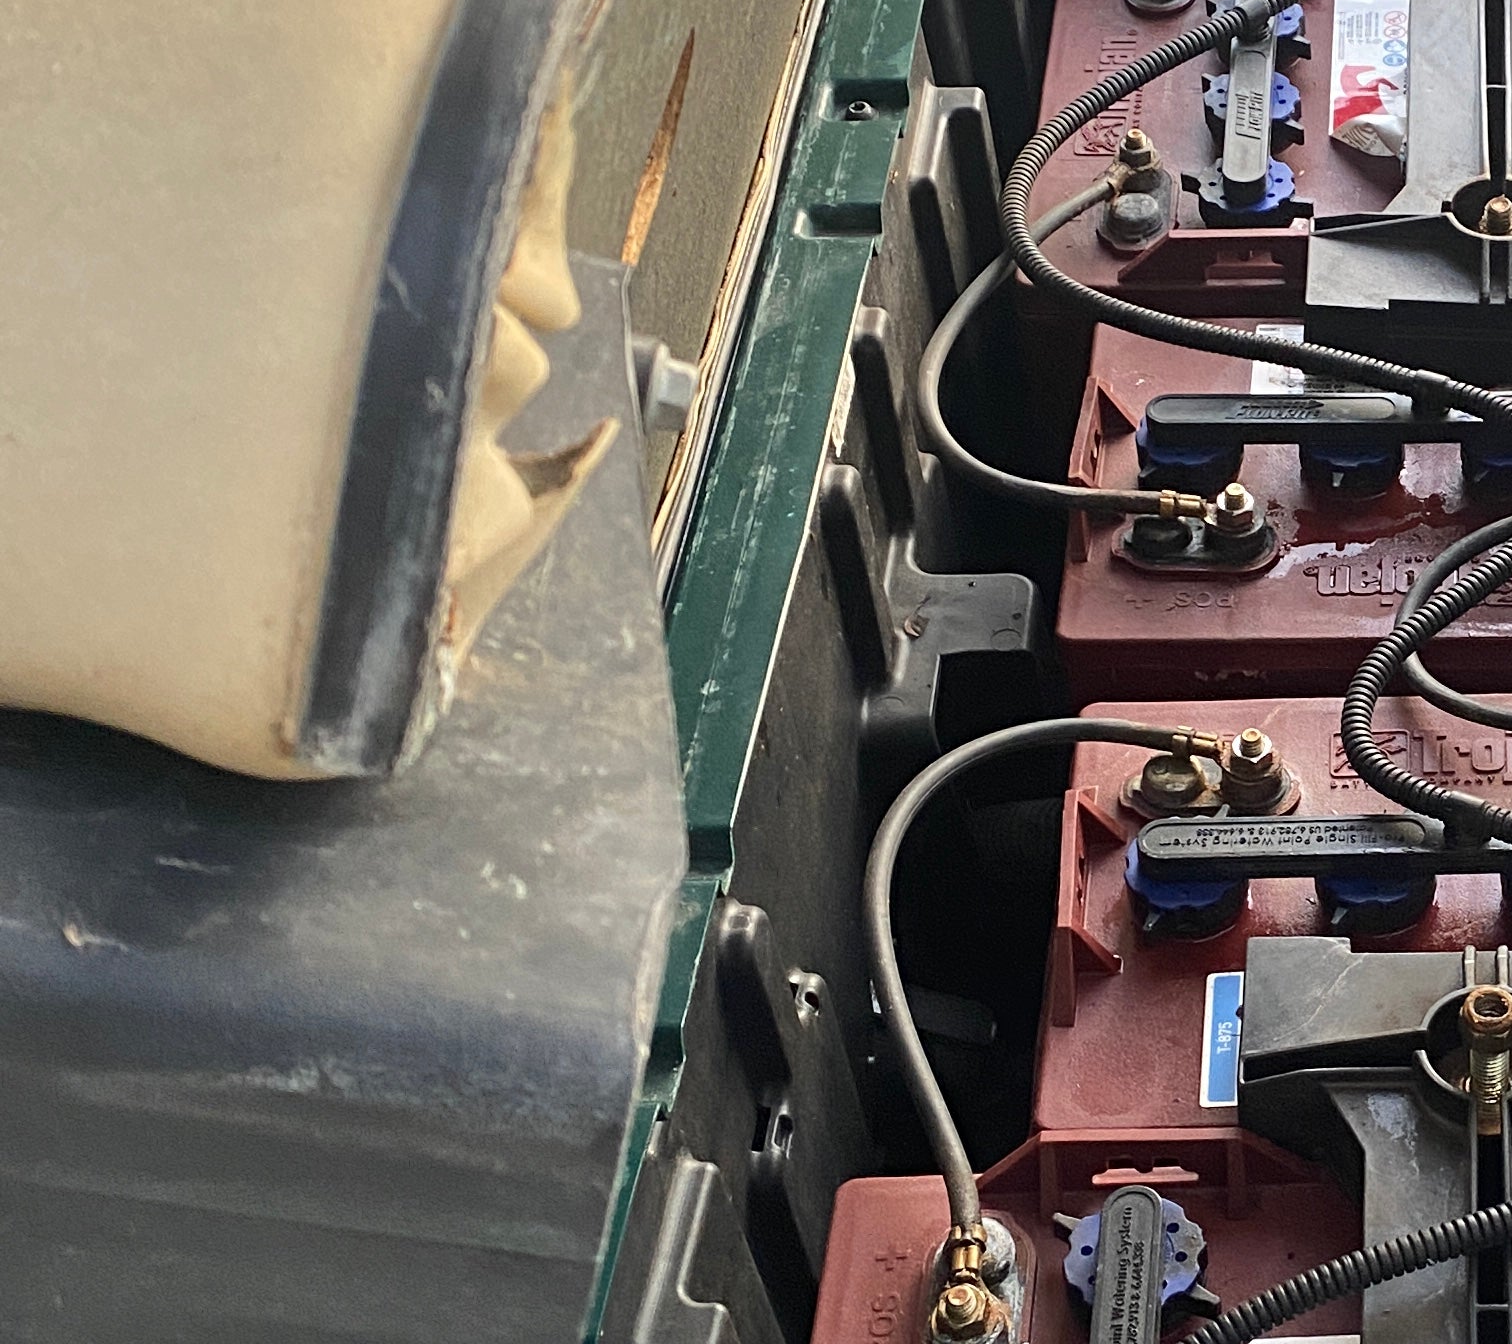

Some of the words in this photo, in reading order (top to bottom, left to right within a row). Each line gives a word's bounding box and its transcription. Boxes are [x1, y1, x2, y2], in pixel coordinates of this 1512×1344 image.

[1175, 592, 1233, 608] POS
[1159, 837, 1208, 848] System
[1213, 836, 1274, 848] Watering
[1278, 835, 1311, 845] Point
[1317, 833, 1357, 845] Single
[1217, 1021, 1233, 1055] T-875
[1117, 1207, 1133, 1256] System
[1112, 1257, 1131, 1322] Watering
